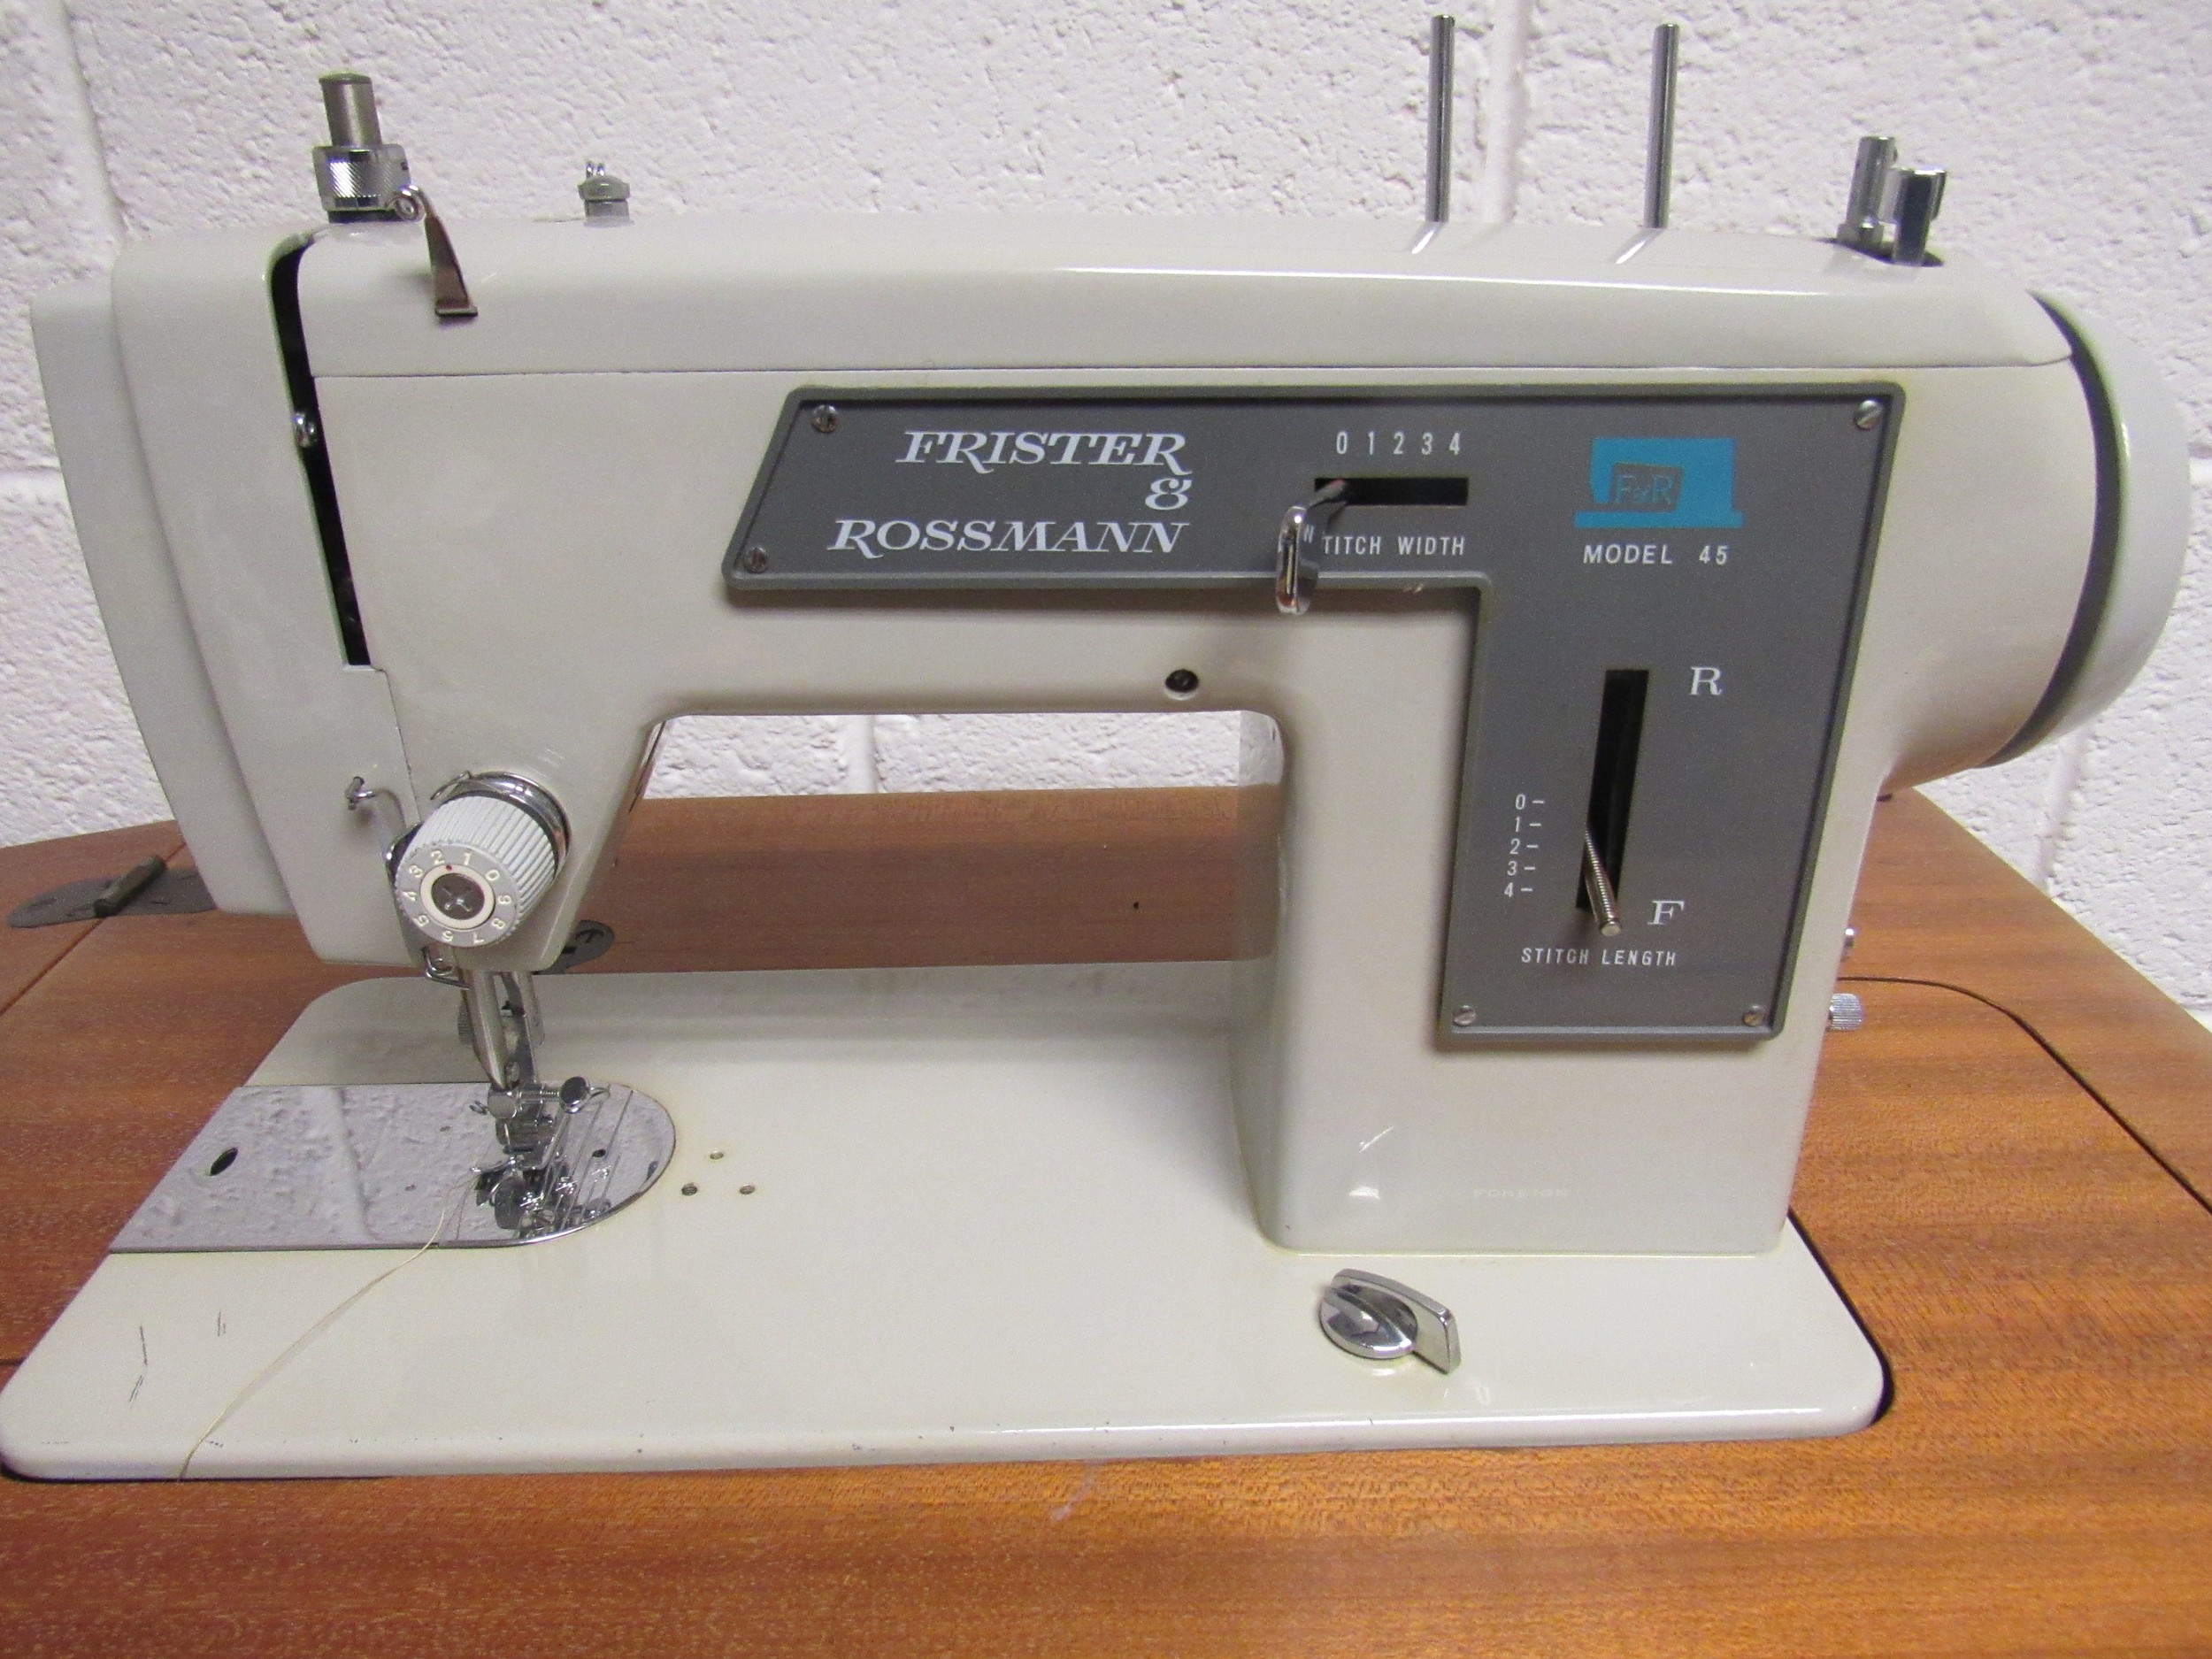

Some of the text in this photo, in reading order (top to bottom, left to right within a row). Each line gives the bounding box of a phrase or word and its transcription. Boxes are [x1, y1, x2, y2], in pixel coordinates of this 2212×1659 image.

[895, 430, 1192, 476] FRISTER
[1335, 430, 1462, 456] 0 1 2 3 4
[1144, 477, 1193, 511] &
[826, 518, 1191, 559] ROSSMANN
[1322, 535, 1466, 556] TITCH WIDTH
[1582, 543, 1728, 565] MODEL 45
[1689, 665, 1723, 696] R
[430, 850, 445, 865] 2
[464, 852, 472, 866] 1
[409, 864, 425, 878] 3
[485, 869, 500, 881] 0
[402, 891, 419, 902] 4
[1647, 900, 1686, 926] F
[491, 918, 506, 930] 8
[1521, 947, 1678, 966] STITCH LENGTH
